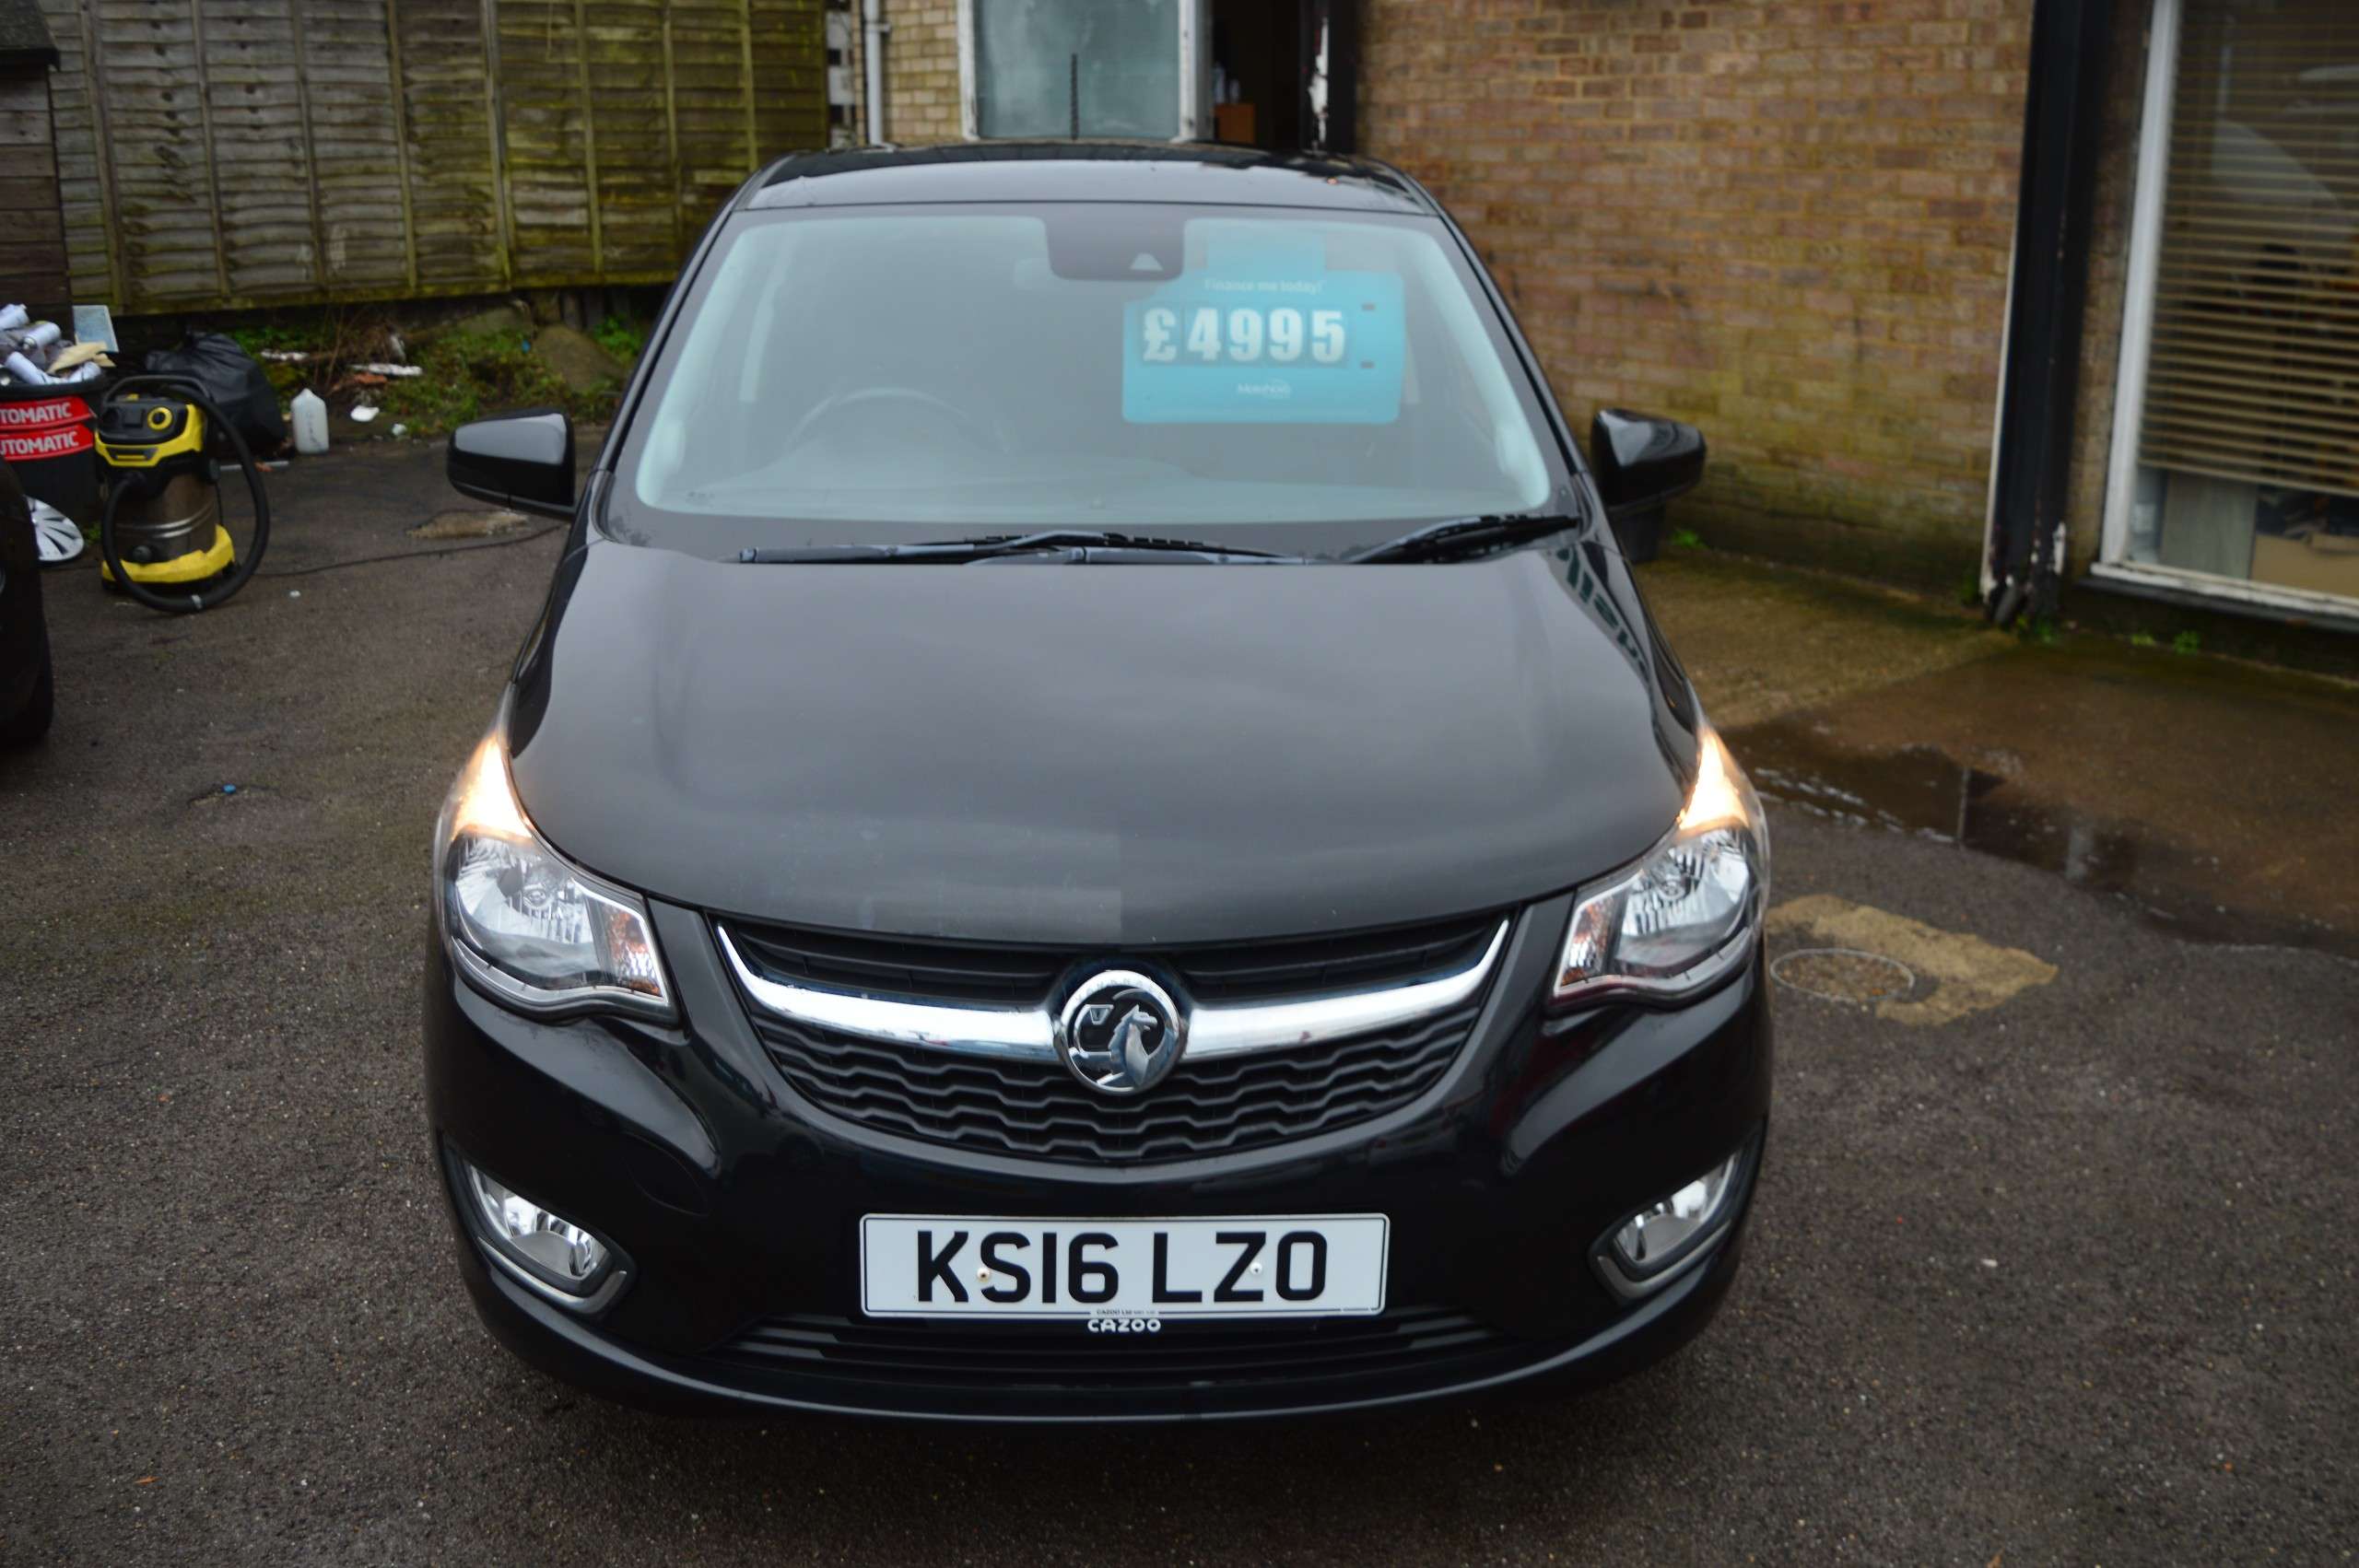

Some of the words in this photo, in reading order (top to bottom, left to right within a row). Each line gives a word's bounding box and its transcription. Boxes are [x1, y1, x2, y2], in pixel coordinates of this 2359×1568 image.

[1143, 307, 1345, 363] £4995
[917, 1230, 1120, 1304] KS16
[1152, 1231, 1328, 1304] LZO
[1087, 1318, 1161, 1333] CAZOO
